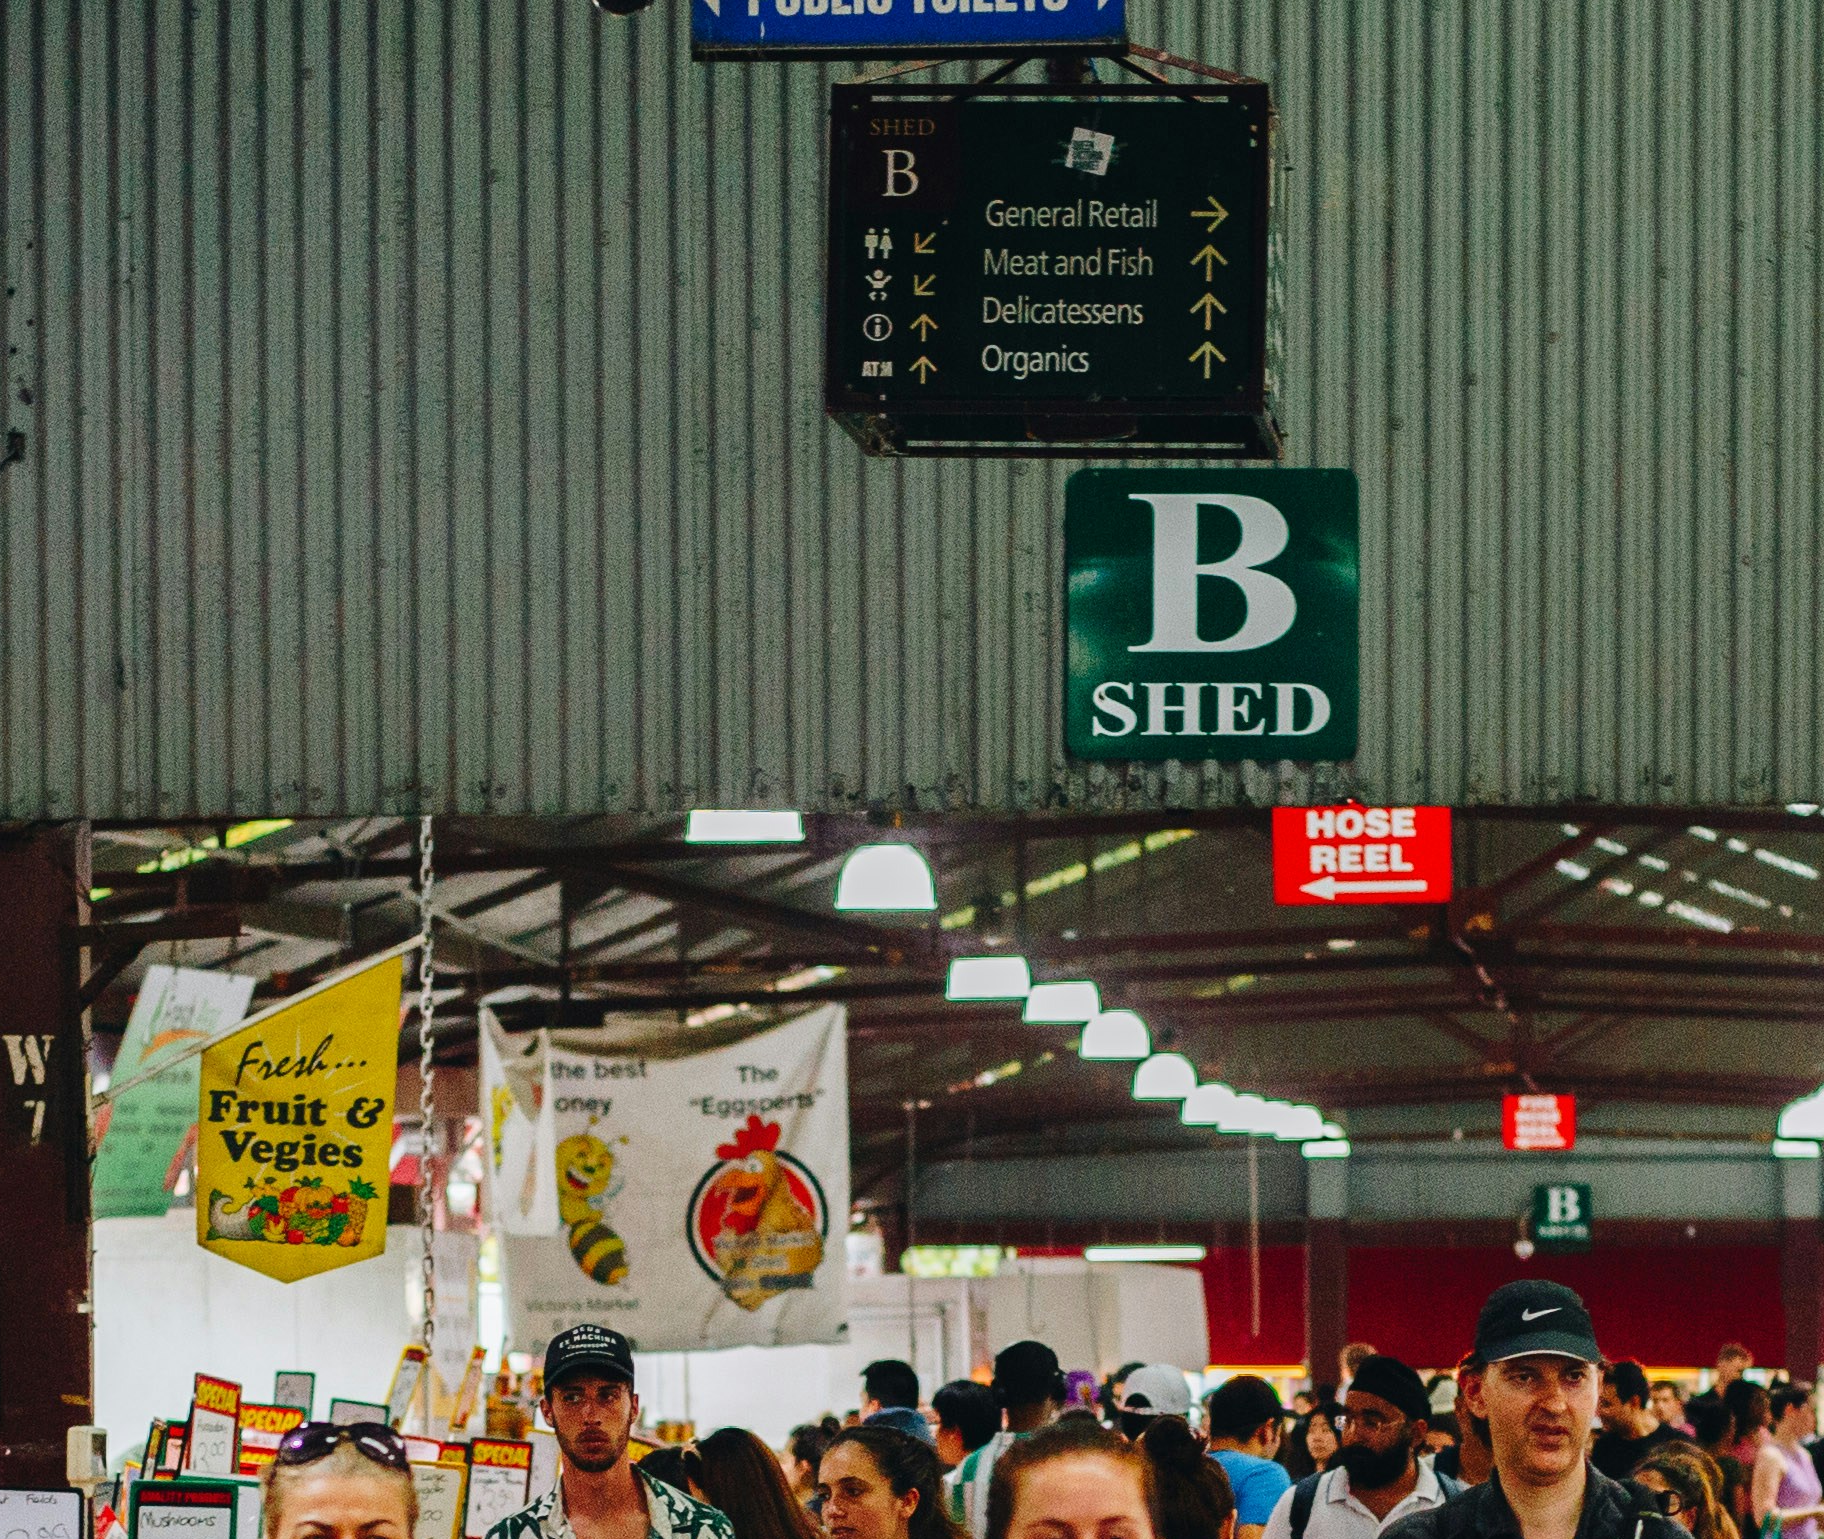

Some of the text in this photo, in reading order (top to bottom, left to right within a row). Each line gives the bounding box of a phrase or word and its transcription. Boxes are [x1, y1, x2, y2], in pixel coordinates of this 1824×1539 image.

[869, 118, 936, 136] SHED
[881, 149, 919, 197] B
[986, 199, 1159, 228] General Retail
[983, 247, 1154, 276] Meat and Fish
[982, 296, 1145, 325] Delicatessens
[861, 361, 894, 377] ATM
[981, 344, 1090, 380] Organics
[1126, 492, 1298, 654] B
[1090, 682, 1333, 739] SHED
[1305, 807, 1417, 840] HOSE
[1309, 843, 1415, 874] REEL
[2, 1034, 55, 1086] W
[550, 1058, 647, 1080] the best
[736, 1064, 778, 1084] The
[23, 1100, 45, 1147] 7
[207, 1089, 386, 1129] Fruit &
[219, 1129, 364, 1173] Vegies
[1547, 1186, 1581, 1223] B
[573, 1333, 617, 1344] MACHINA
